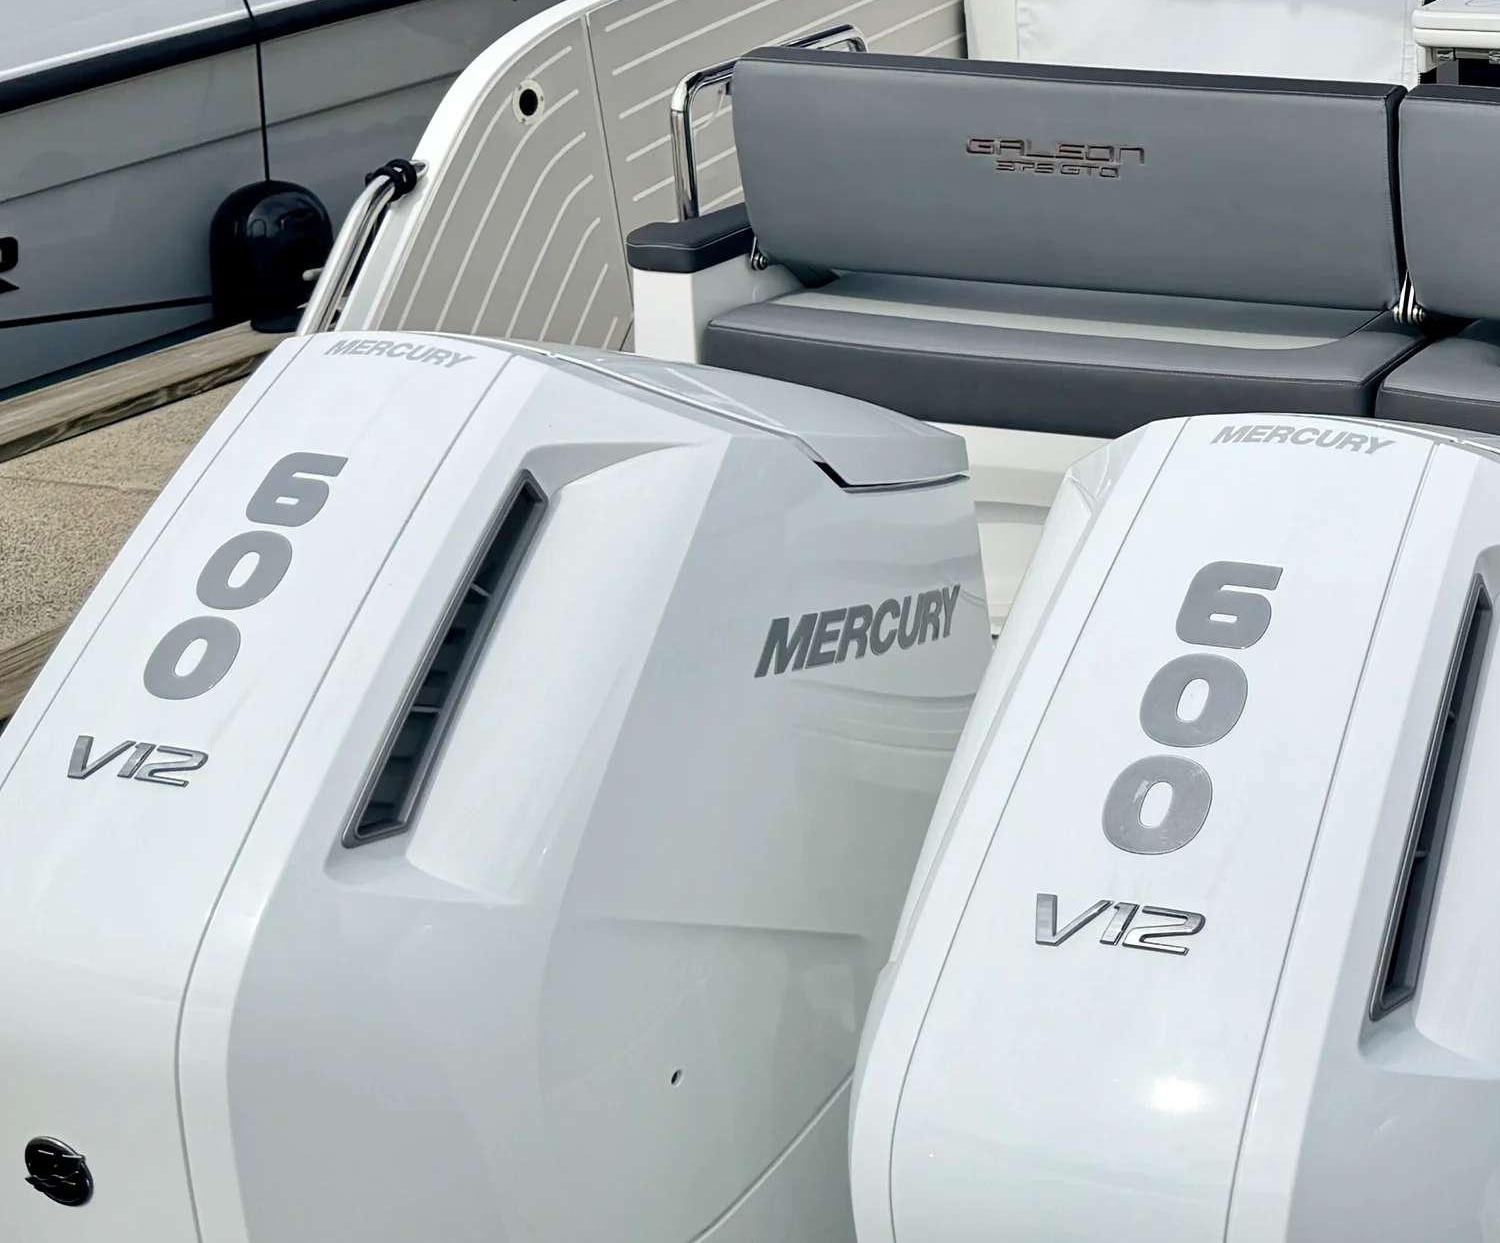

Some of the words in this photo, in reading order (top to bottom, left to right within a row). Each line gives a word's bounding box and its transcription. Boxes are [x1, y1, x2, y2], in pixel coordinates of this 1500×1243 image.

[965, 137, 1146, 165] GALEON
[1060, 164, 1120, 179] GTO
[323, 339, 478, 369] MERCURY
[1210, 425, 1396, 455] MERCURY
[143, 451, 349, 700] 600
[754, 584, 961, 678] MERCURY
[1101, 560, 1284, 856] 600
[67, 735, 209, 788] V12
[1035, 893, 1206, 955] V12
